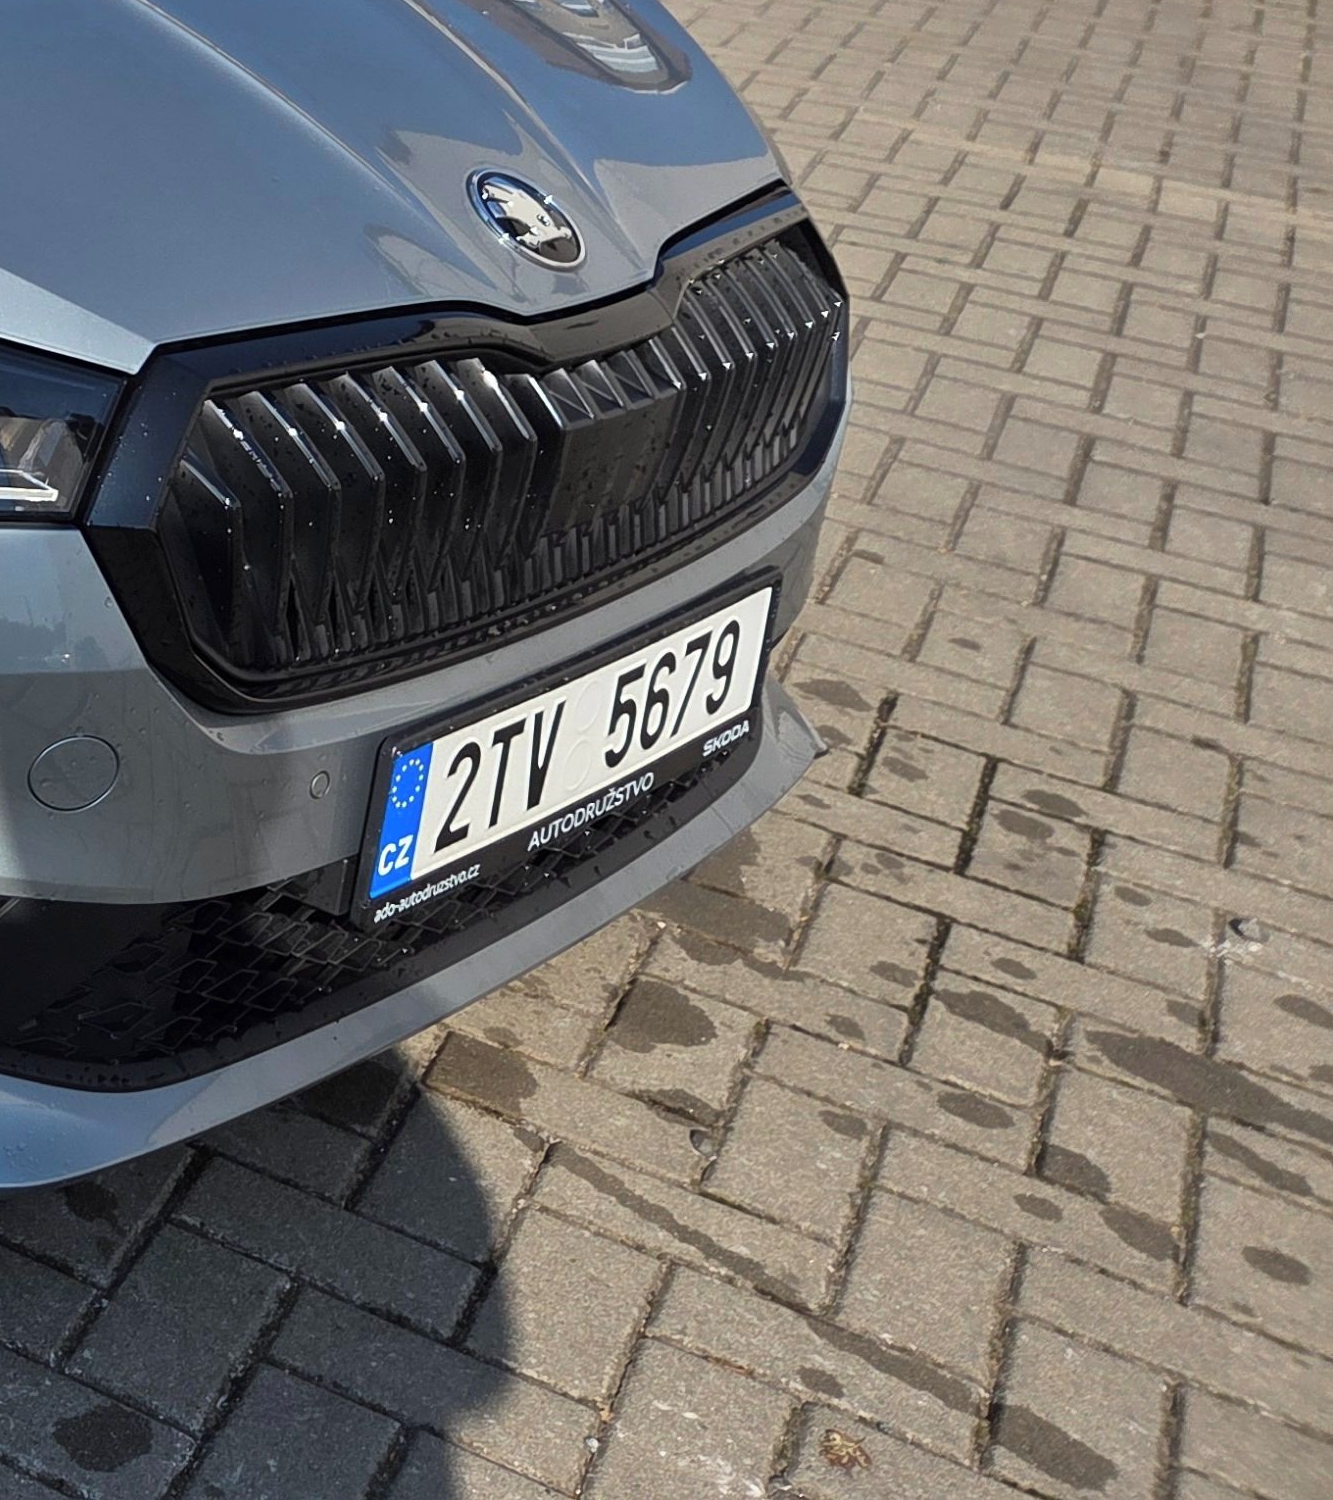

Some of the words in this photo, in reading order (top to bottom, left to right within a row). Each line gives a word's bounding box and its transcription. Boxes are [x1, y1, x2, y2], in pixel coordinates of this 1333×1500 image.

[434, 700, 567, 854] 2TV
[605, 619, 741, 769] 5679
[527, 773, 655, 852] AUTODRUŽSTVO
[378, 835, 413, 876] CZ
